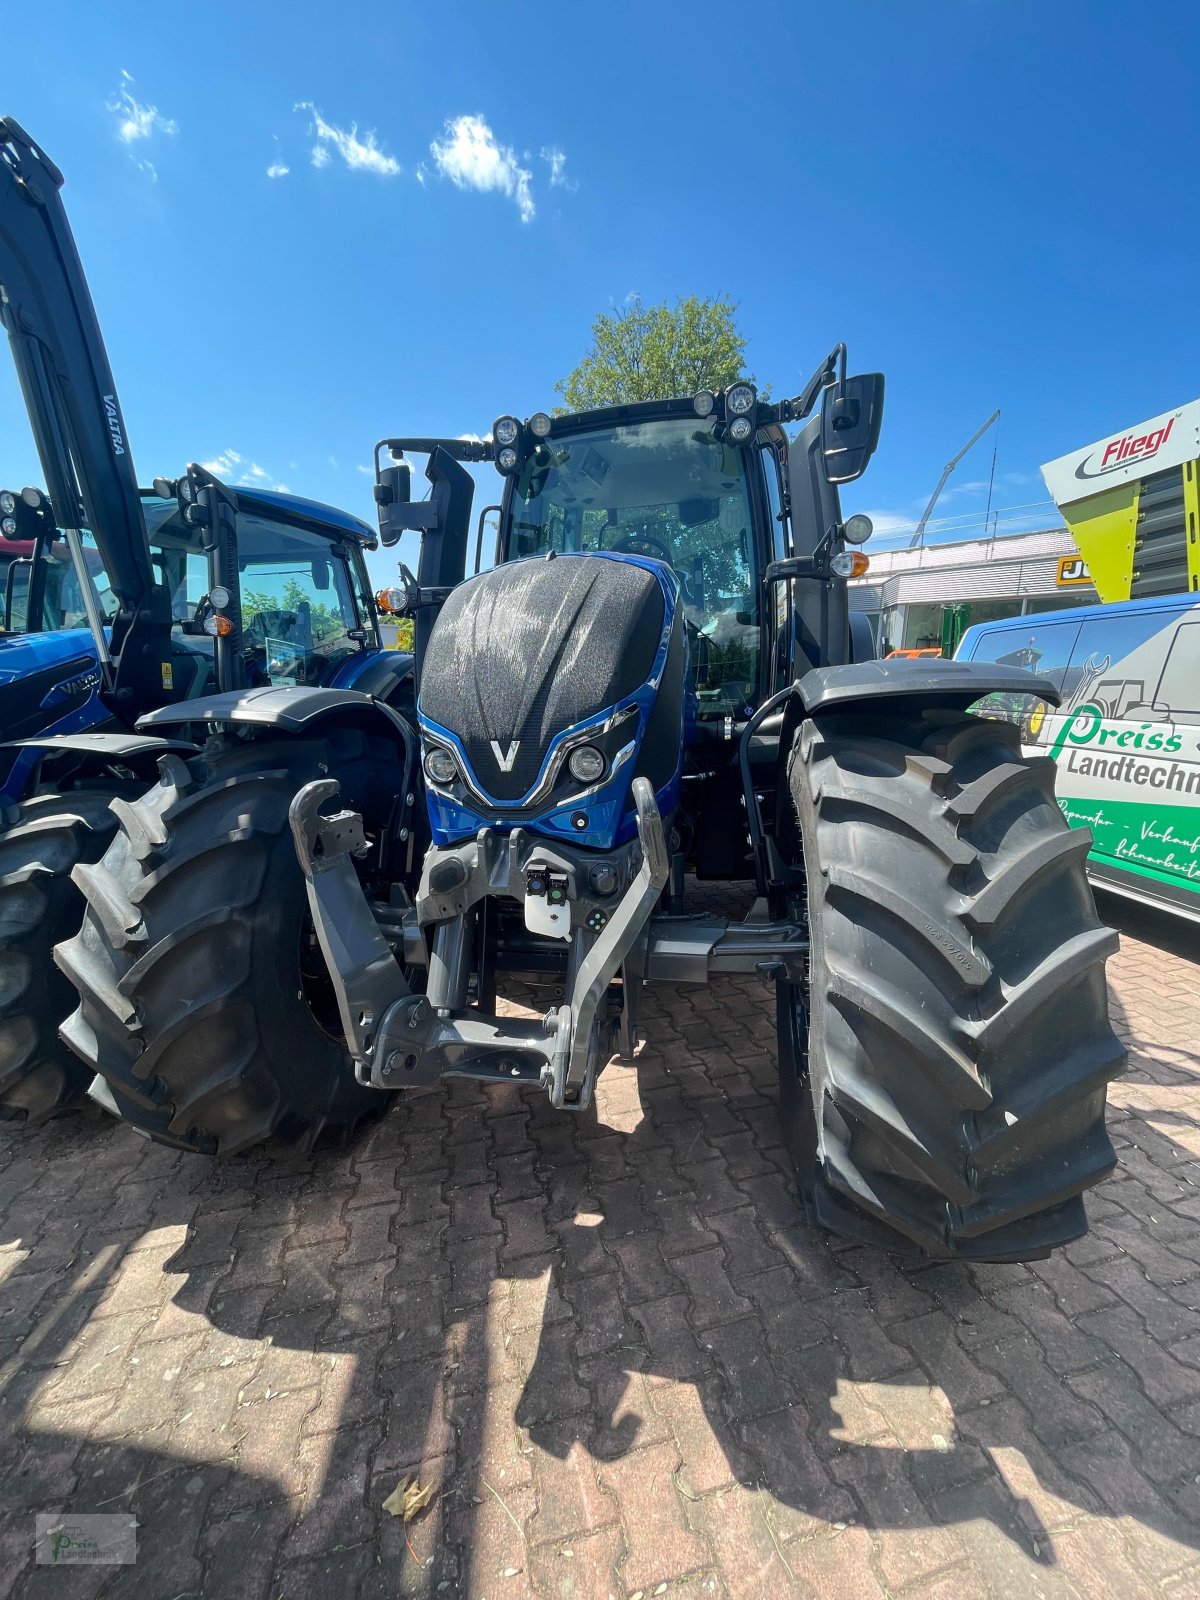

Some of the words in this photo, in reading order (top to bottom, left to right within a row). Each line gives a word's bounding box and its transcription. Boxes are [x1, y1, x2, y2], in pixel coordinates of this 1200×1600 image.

[103, 394, 125, 455] VALTRA
[1101, 417, 1175, 466] Fliegl
[490, 740, 520, 772] V
[1048, 704, 1183, 761] Preiss
